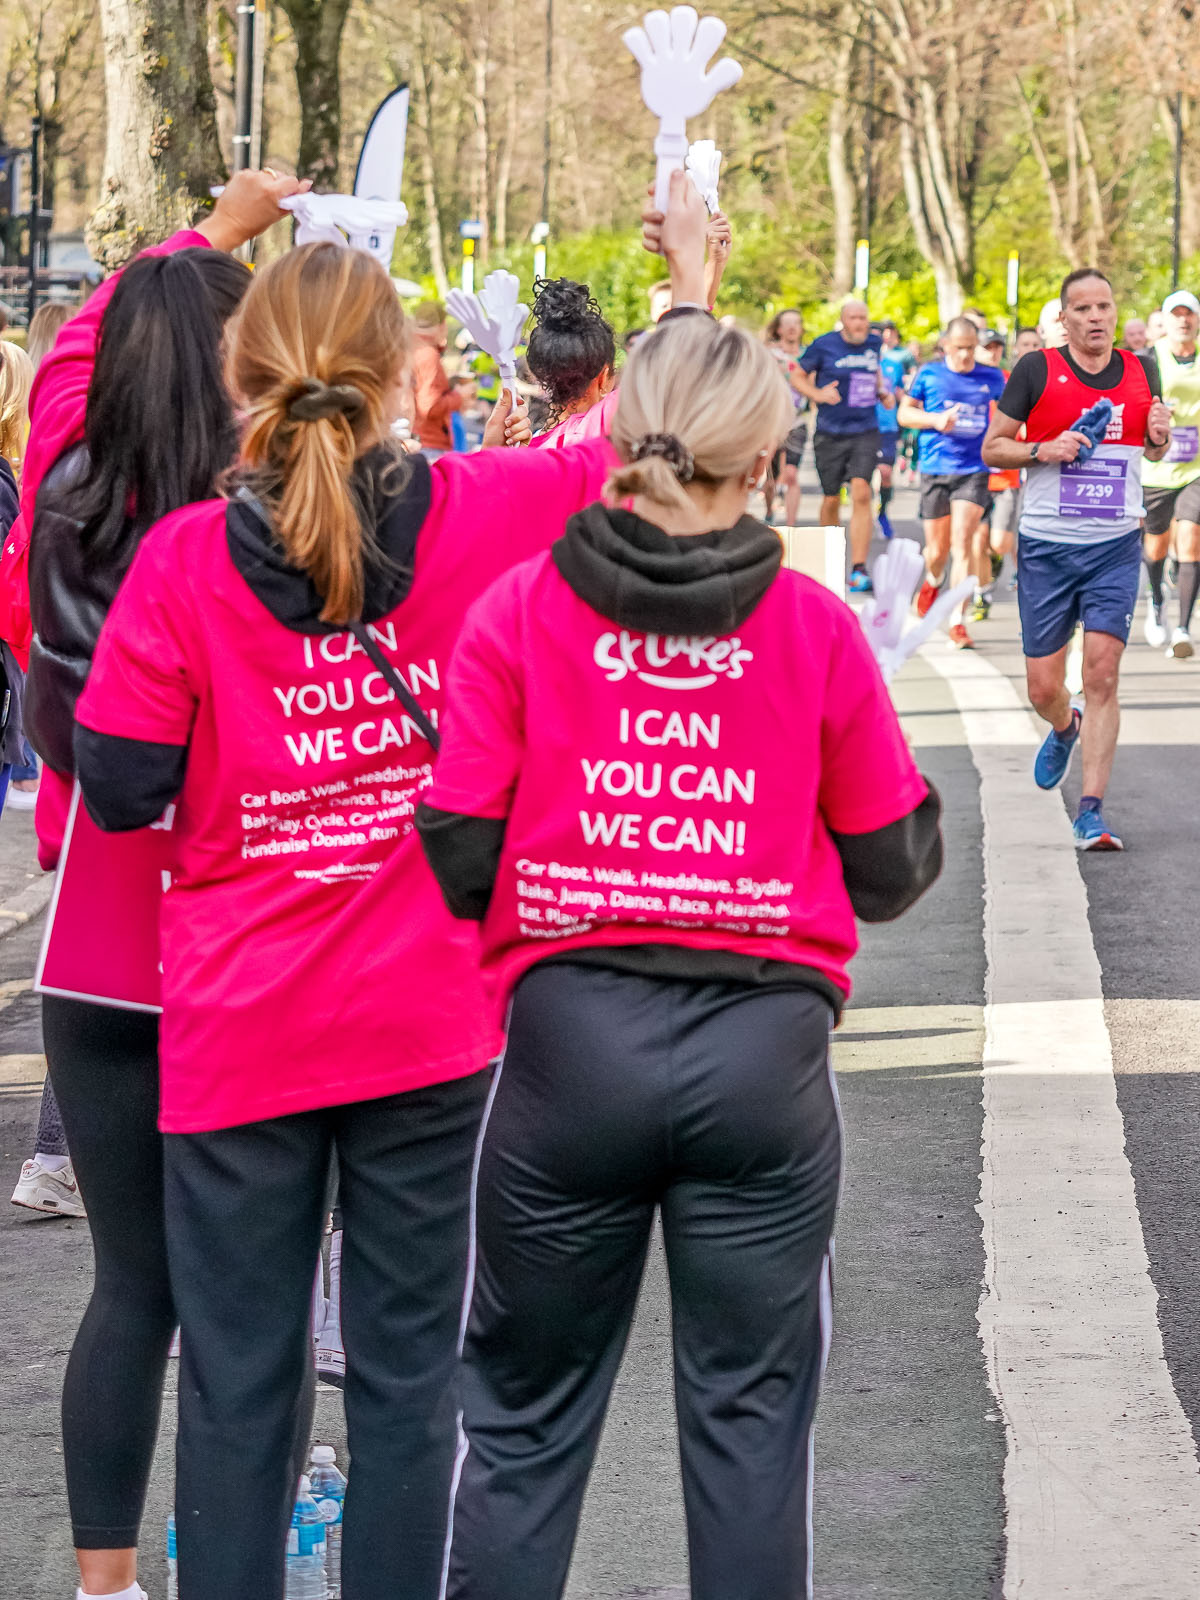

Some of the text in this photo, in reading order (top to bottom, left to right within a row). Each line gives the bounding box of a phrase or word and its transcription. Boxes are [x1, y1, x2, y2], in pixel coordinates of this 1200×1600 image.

[1076, 484, 1114, 498] 7239
[303, 622, 398, 668] I CAN
[273, 678, 354, 718] YOU
[284, 727, 347, 766] WE
[620, 708, 721, 750] I CAN
[240, 793, 268, 808] Car
[580, 758, 756, 805] YOU CAN
[348, 812, 376, 827] Car
[578, 810, 746, 856] WE CAN!
[516, 858, 546, 877] Car
[548, 862, 592, 882] Boot.
[592, 866, 638, 888] Walk.
[610, 890, 666, 912] Dance.
